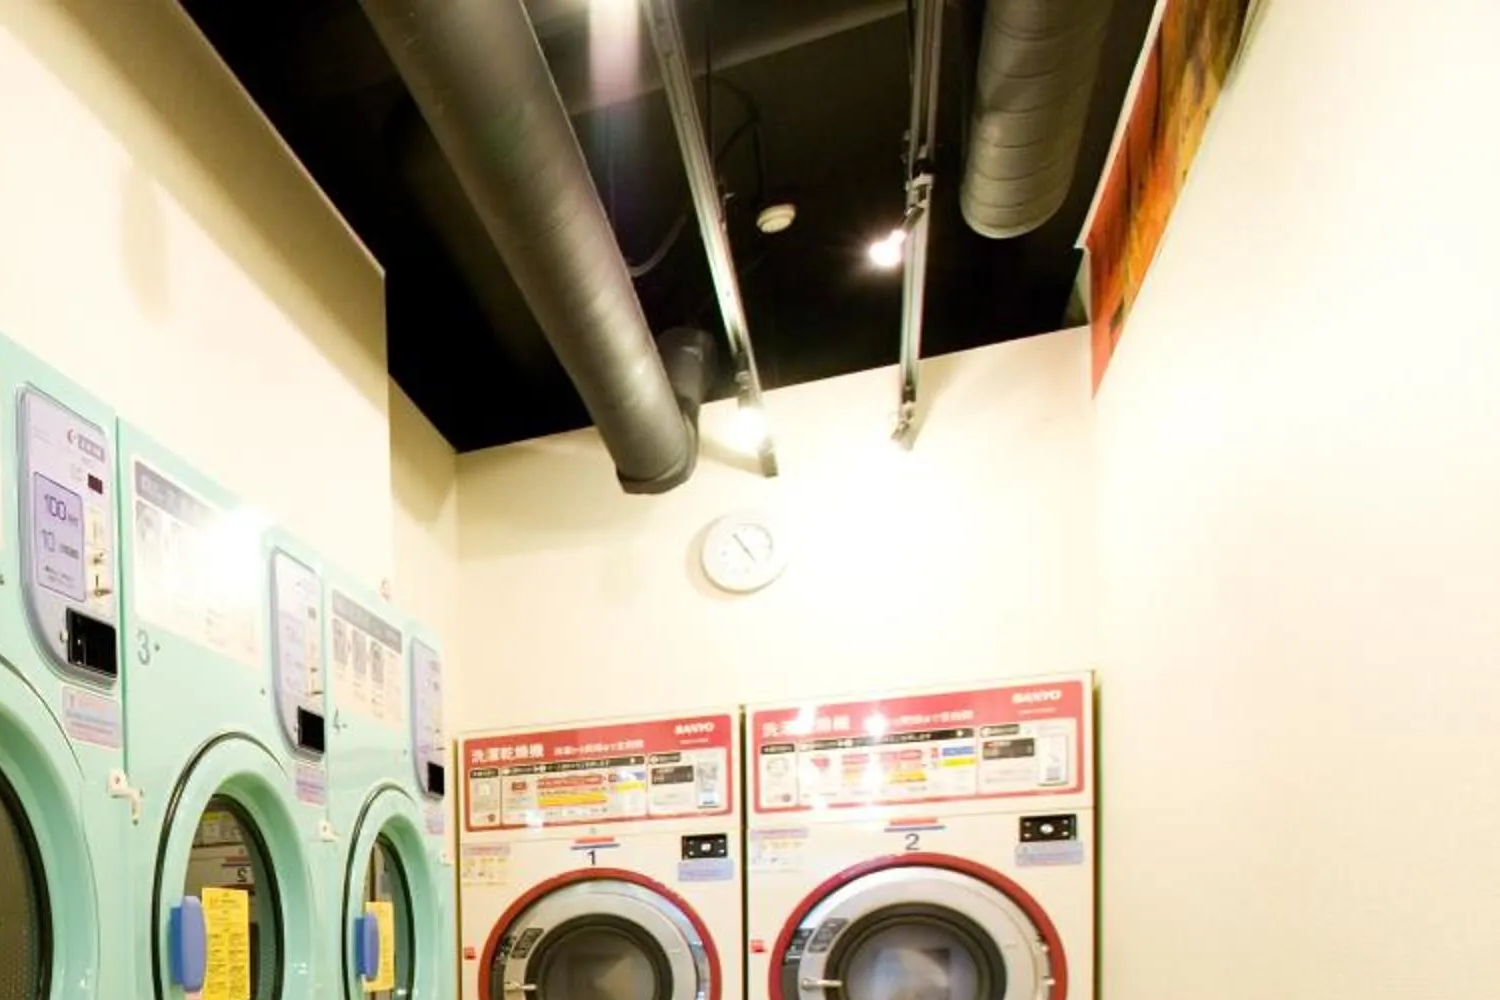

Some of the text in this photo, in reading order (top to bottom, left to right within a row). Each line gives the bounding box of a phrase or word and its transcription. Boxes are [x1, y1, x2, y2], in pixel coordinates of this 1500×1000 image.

[137, 630, 151, 665] 3
[905, 834, 920, 851] 2
[587, 850, 596, 865] 1
